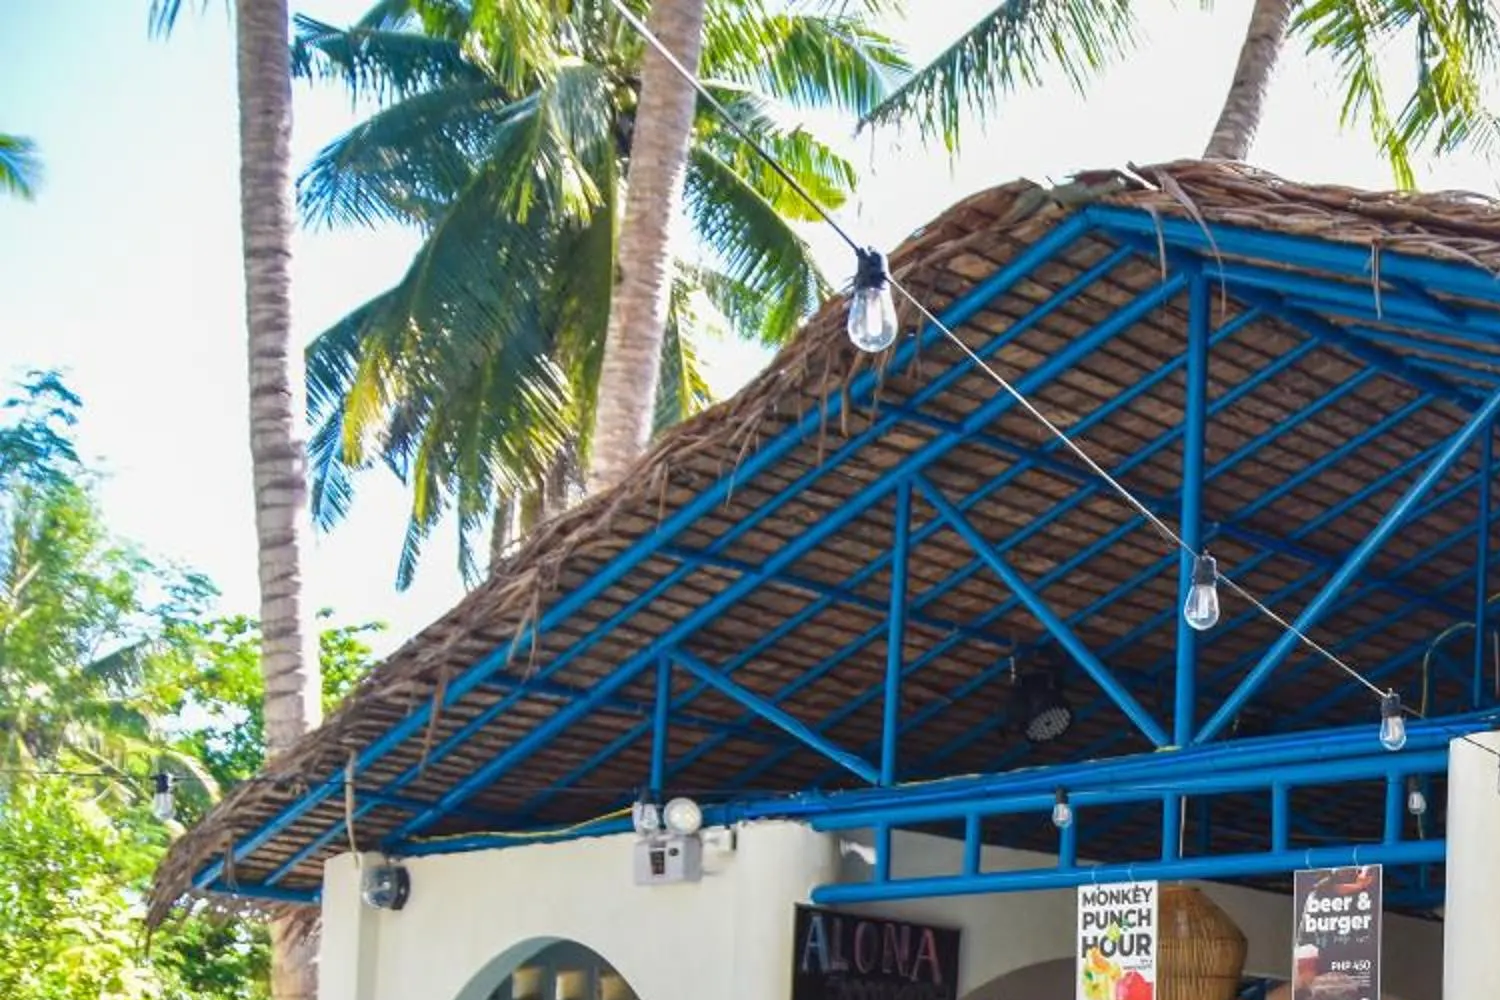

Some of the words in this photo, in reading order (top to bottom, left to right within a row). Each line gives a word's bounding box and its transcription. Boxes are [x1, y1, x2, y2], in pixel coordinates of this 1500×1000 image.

[1082, 886, 1152, 907] MONKEY
[1306, 892, 1352, 913] beer
[1357, 891, 1371, 911] &
[1082, 908, 1152, 931] PUNCH
[1305, 914, 1372, 935] burger
[802, 914, 943, 986] ALONA
[1081, 934, 1152, 959] HOUR
[1331, 961, 1351, 971] PHP
